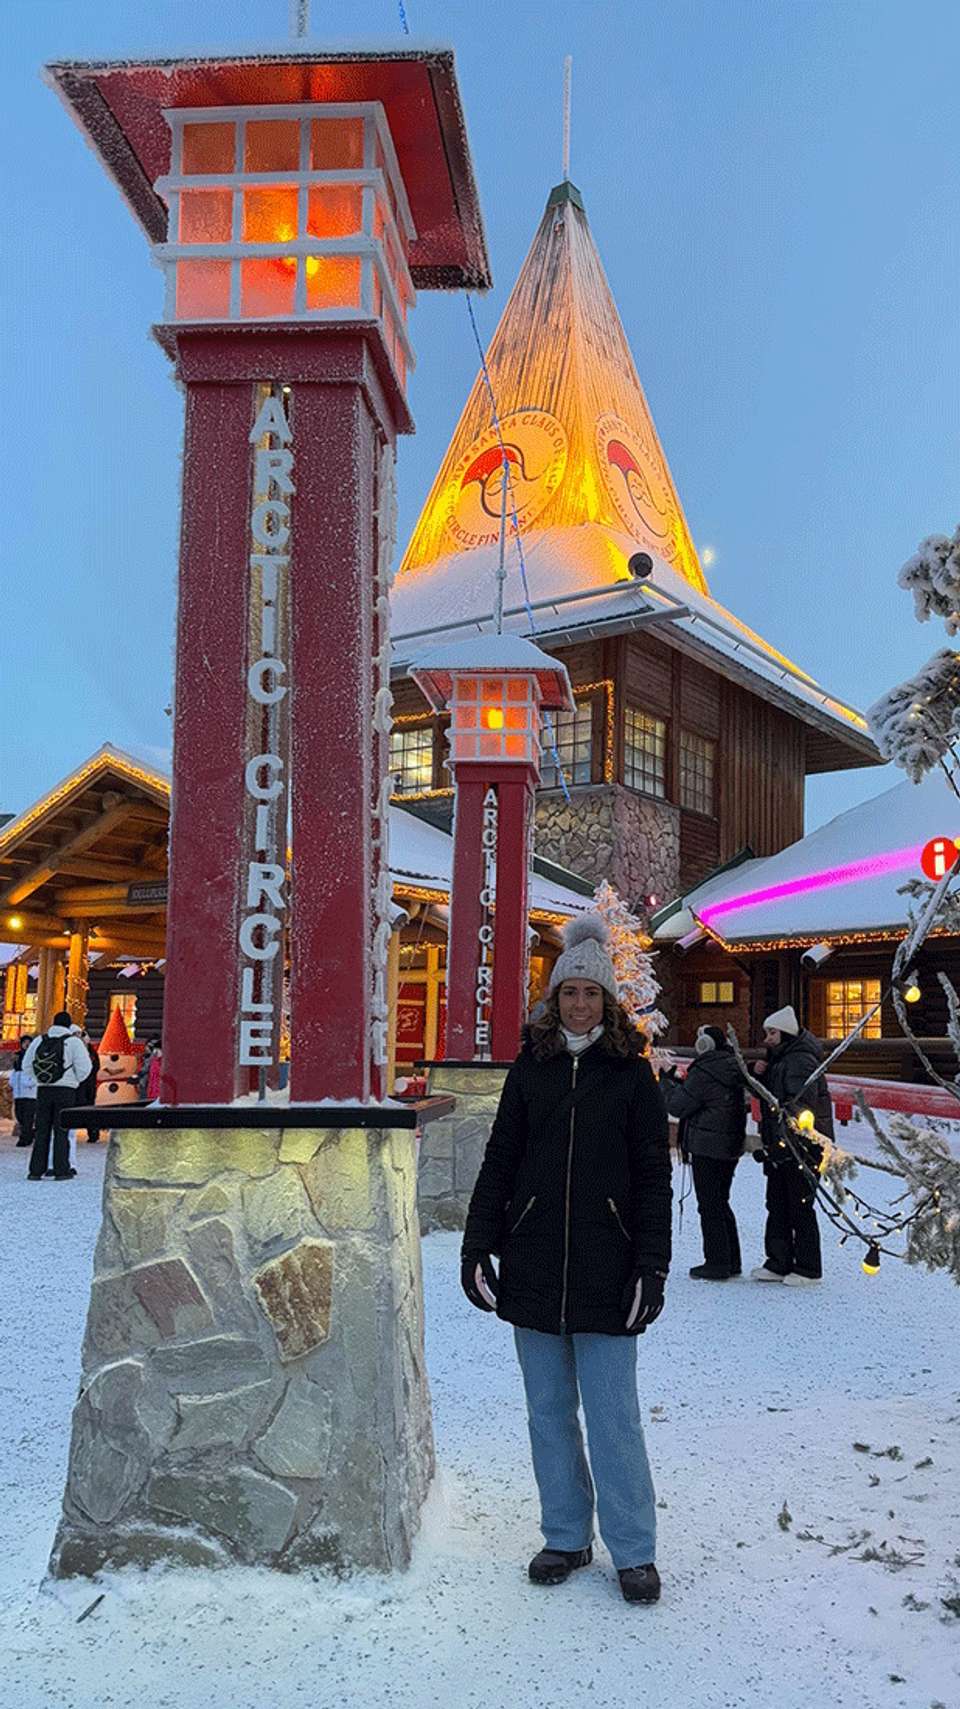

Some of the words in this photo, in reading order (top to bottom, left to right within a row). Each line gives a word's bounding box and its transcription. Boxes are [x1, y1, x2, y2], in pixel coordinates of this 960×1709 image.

[522, 414, 560, 437] CLAUS
[249, 397, 296, 704] ARCTIC
[446, 515, 478, 546] CIRCLE
[479, 788, 497, 906] ARCTIC
[239, 754, 286, 1066] CIRCLE
[475, 925, 494, 1045] CIRCLE
